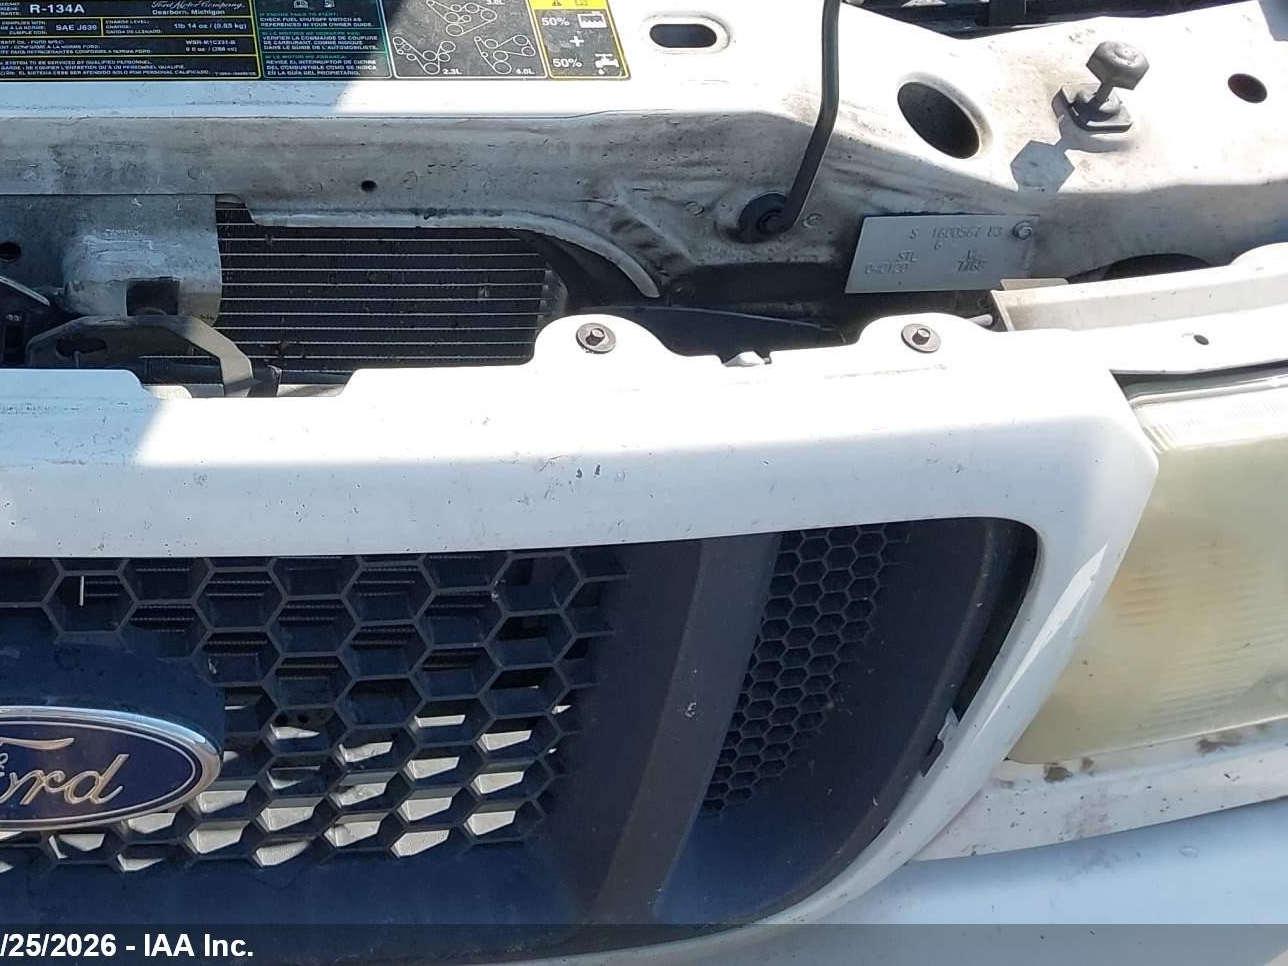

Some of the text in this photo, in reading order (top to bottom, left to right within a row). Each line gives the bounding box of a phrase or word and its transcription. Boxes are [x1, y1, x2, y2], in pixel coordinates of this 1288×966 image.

[29, 4, 86, 14] R-134A
[541, 17, 570, 26] 50%
[552, 58, 583, 68] 50%
